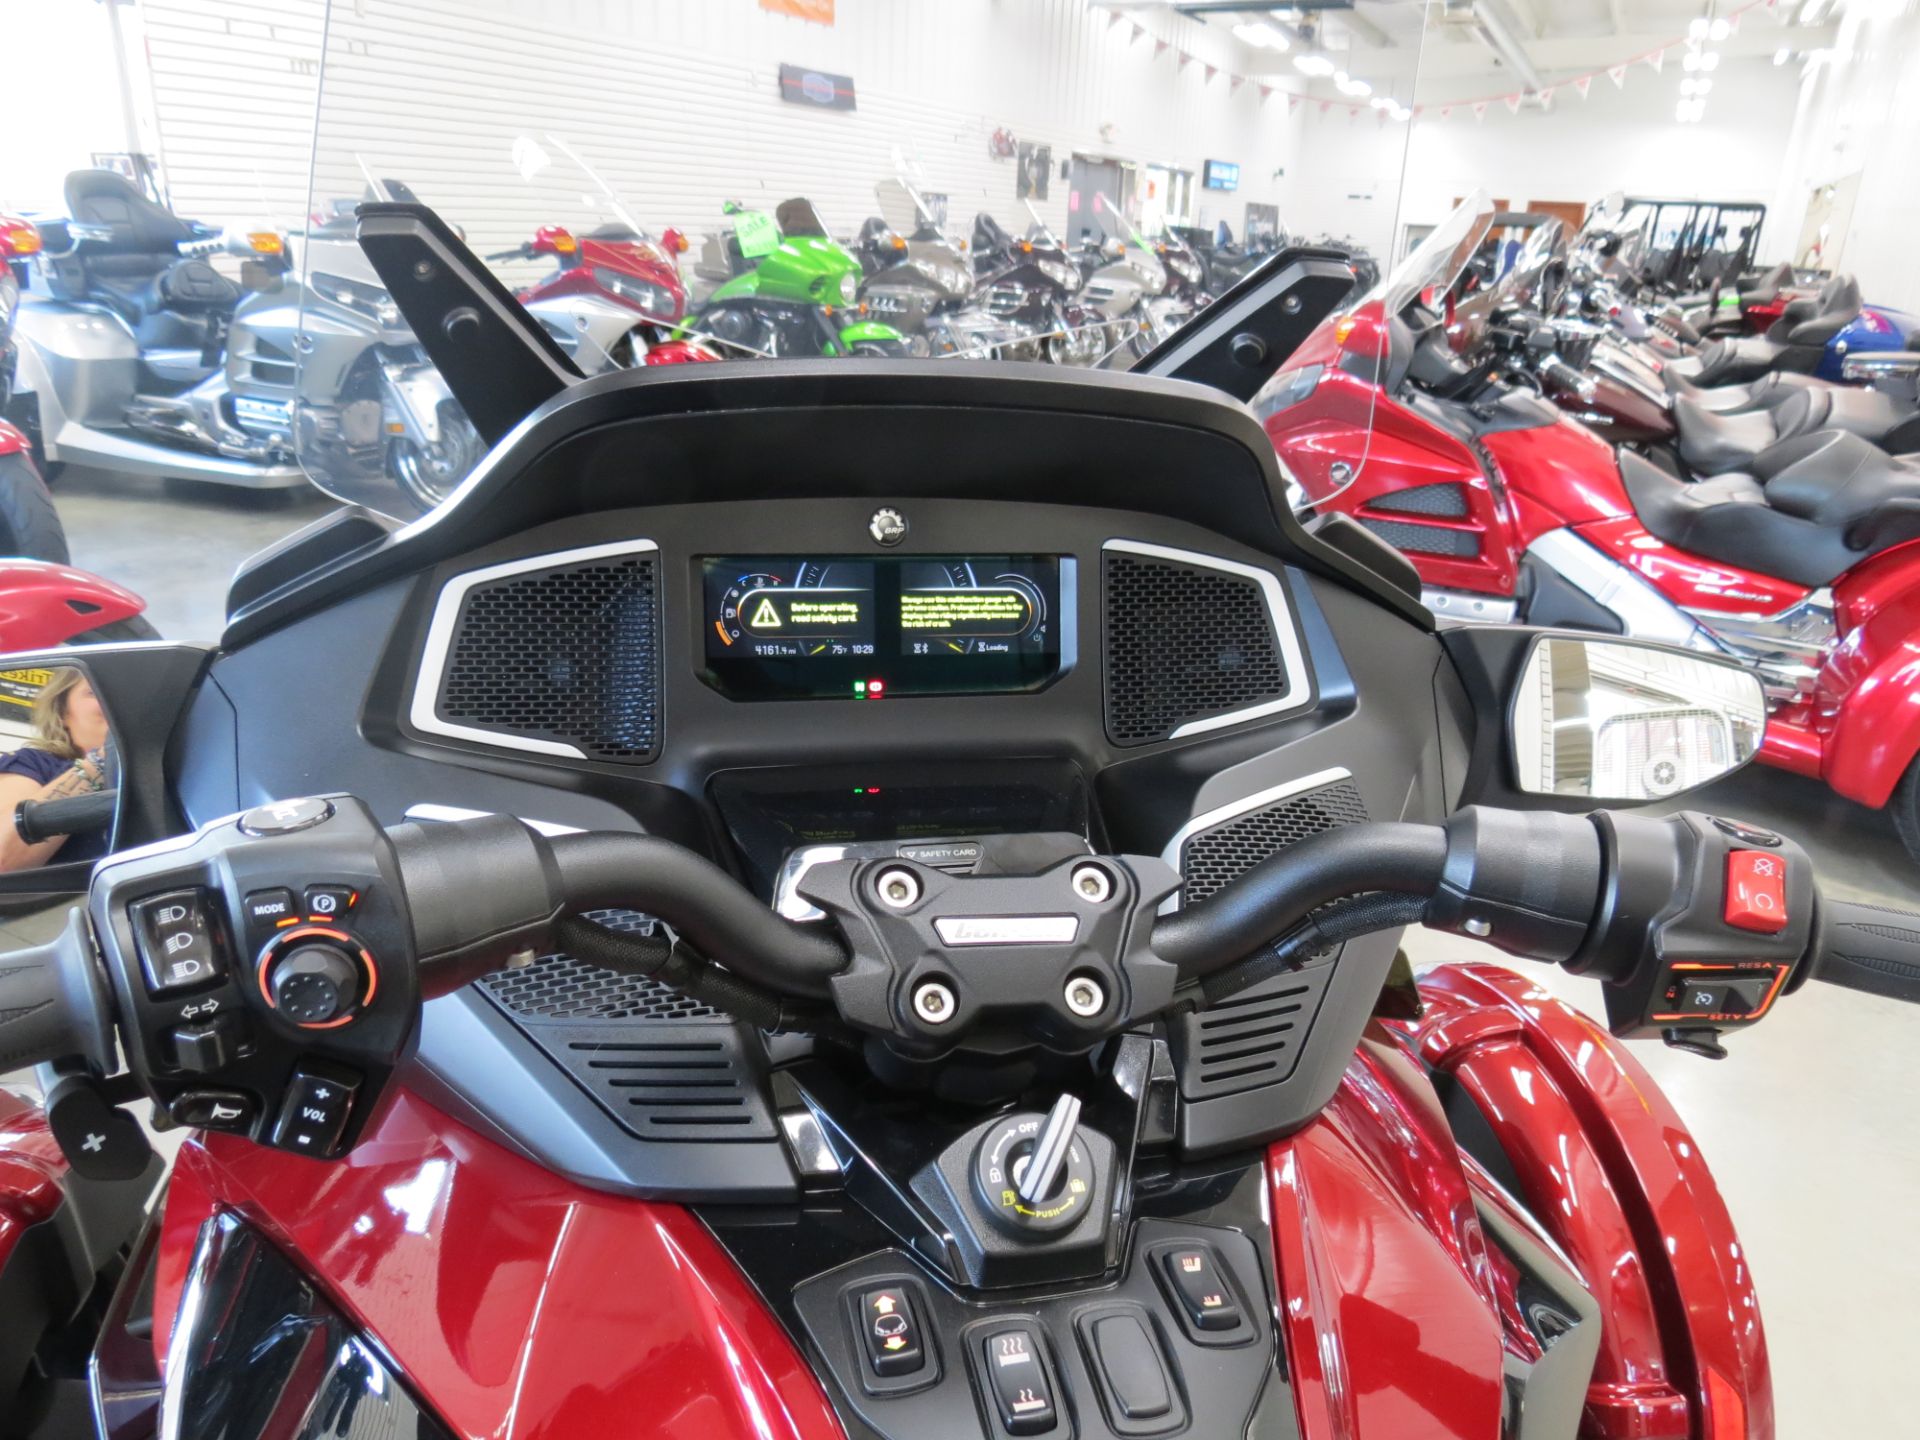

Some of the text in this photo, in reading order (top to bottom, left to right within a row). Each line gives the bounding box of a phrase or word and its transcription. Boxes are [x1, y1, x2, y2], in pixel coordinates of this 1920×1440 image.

[791, 603, 818, 612] Before
[791, 614, 811, 622] read
[811, 614, 837, 624] safety
[920, 848, 977, 858] SAFETY CARD
[254, 903, 285, 915] MODE
[302, 1107, 327, 1123] VOL
[1019, 1122, 1038, 1133] OFF
[1035, 1207, 1061, 1218] PUSH
